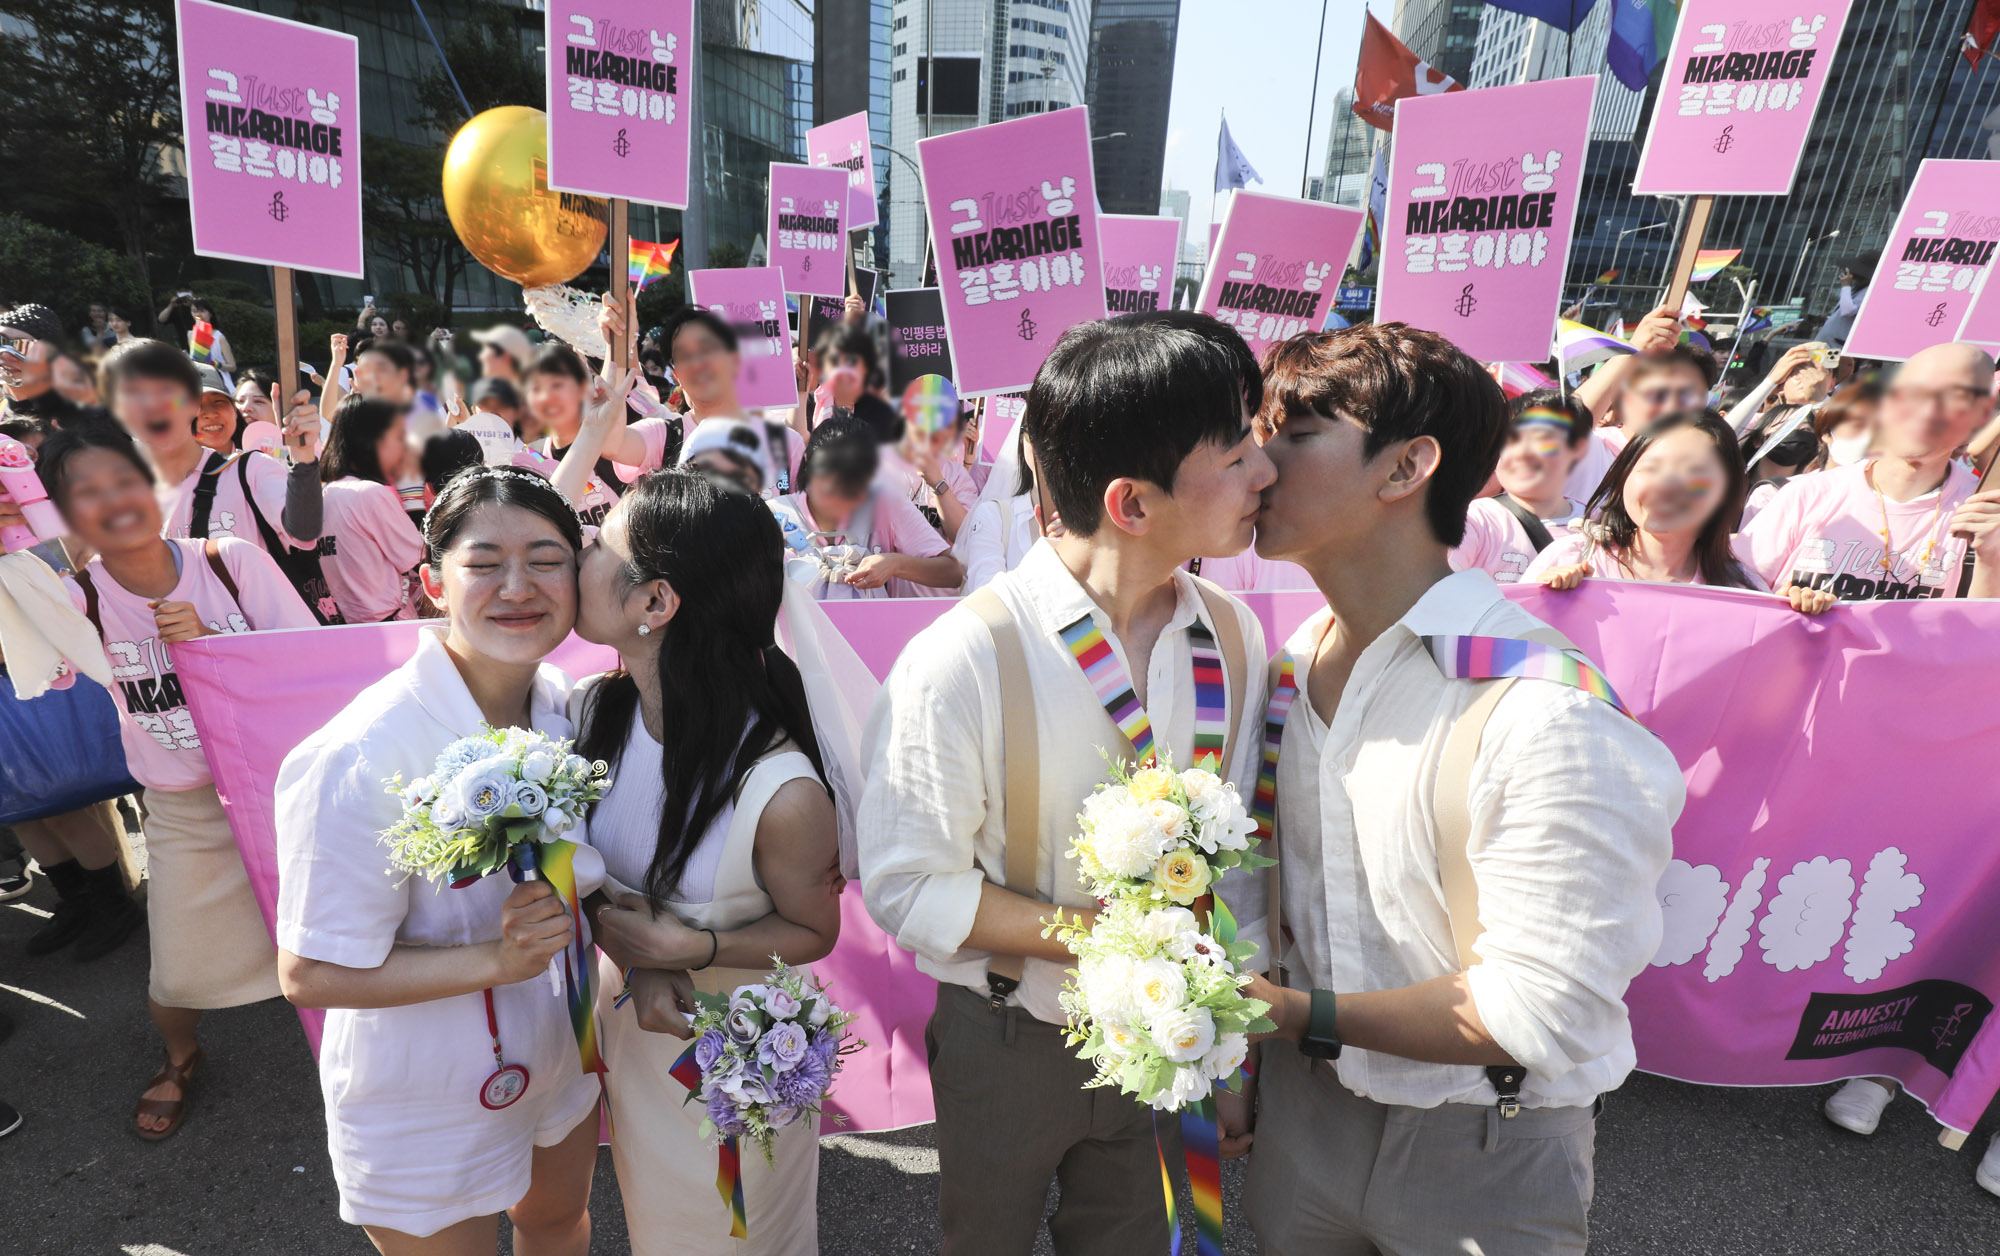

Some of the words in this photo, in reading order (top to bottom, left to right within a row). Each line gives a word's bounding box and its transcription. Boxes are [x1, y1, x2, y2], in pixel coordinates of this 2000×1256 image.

[567, 14, 596, 47] 그
[597, 19, 649, 58] Just
[650, 29, 677, 64] 냥
[1692, 23, 1727, 53] 그
[1730, 19, 1789, 54] Just
[1788, 13, 1828, 49] 냥
[566, 46, 677, 94] MARRIAGE
[1682, 49, 1817, 85] MARRIAGE
[205, 68, 243, 103] 그
[243, 75, 305, 119] Just
[306, 87, 341, 125] 냥
[567, 77, 676, 125] 결혼이야
[1677, 80, 1804, 117] 결혼이야
[205, 101, 342, 157] MARRIAGE
[208, 134, 343, 190] 결혼이야
[1410, 163, 1447, 198] 그
[1452, 157, 1519, 199] Just
[1521, 149, 1563, 193] 냥
[778, 214, 840, 234] MARRIAGE
[779, 197, 795, 213] 그
[824, 199, 840, 218] 냥
[950, 198, 984, 234] 그
[981, 186, 1041, 230] Just
[1040, 176, 1077, 217] 냥
[1405, 192, 1557, 235] MARRIAGE
[1914, 210, 1950, 236] 그
[779, 230, 839, 252] 결혼이야
[952, 215, 1082, 270] MARRIAGE
[1404, 230, 1549, 274] 결혼이야
[958, 251, 1086, 306] 결혼이야
[1139, 264, 1162, 291] 냥
[1228, 252, 1257, 280] 그
[1258, 254, 1305, 288] Just
[1302, 261, 1332, 291] 냥
[759, 300, 777, 321] 냥
[1105, 287, 1160, 312] RIAGE
[1217, 281, 1322, 319] MARRIAGE
[892, 326, 947, 341] 인평등법
[898, 343, 942, 358] 정하라
[107, 641, 149, 678] 그
[1820, 995, 1919, 1031] AMNESTY
[1813, 1019, 1903, 1046] INTERNATIONAL
